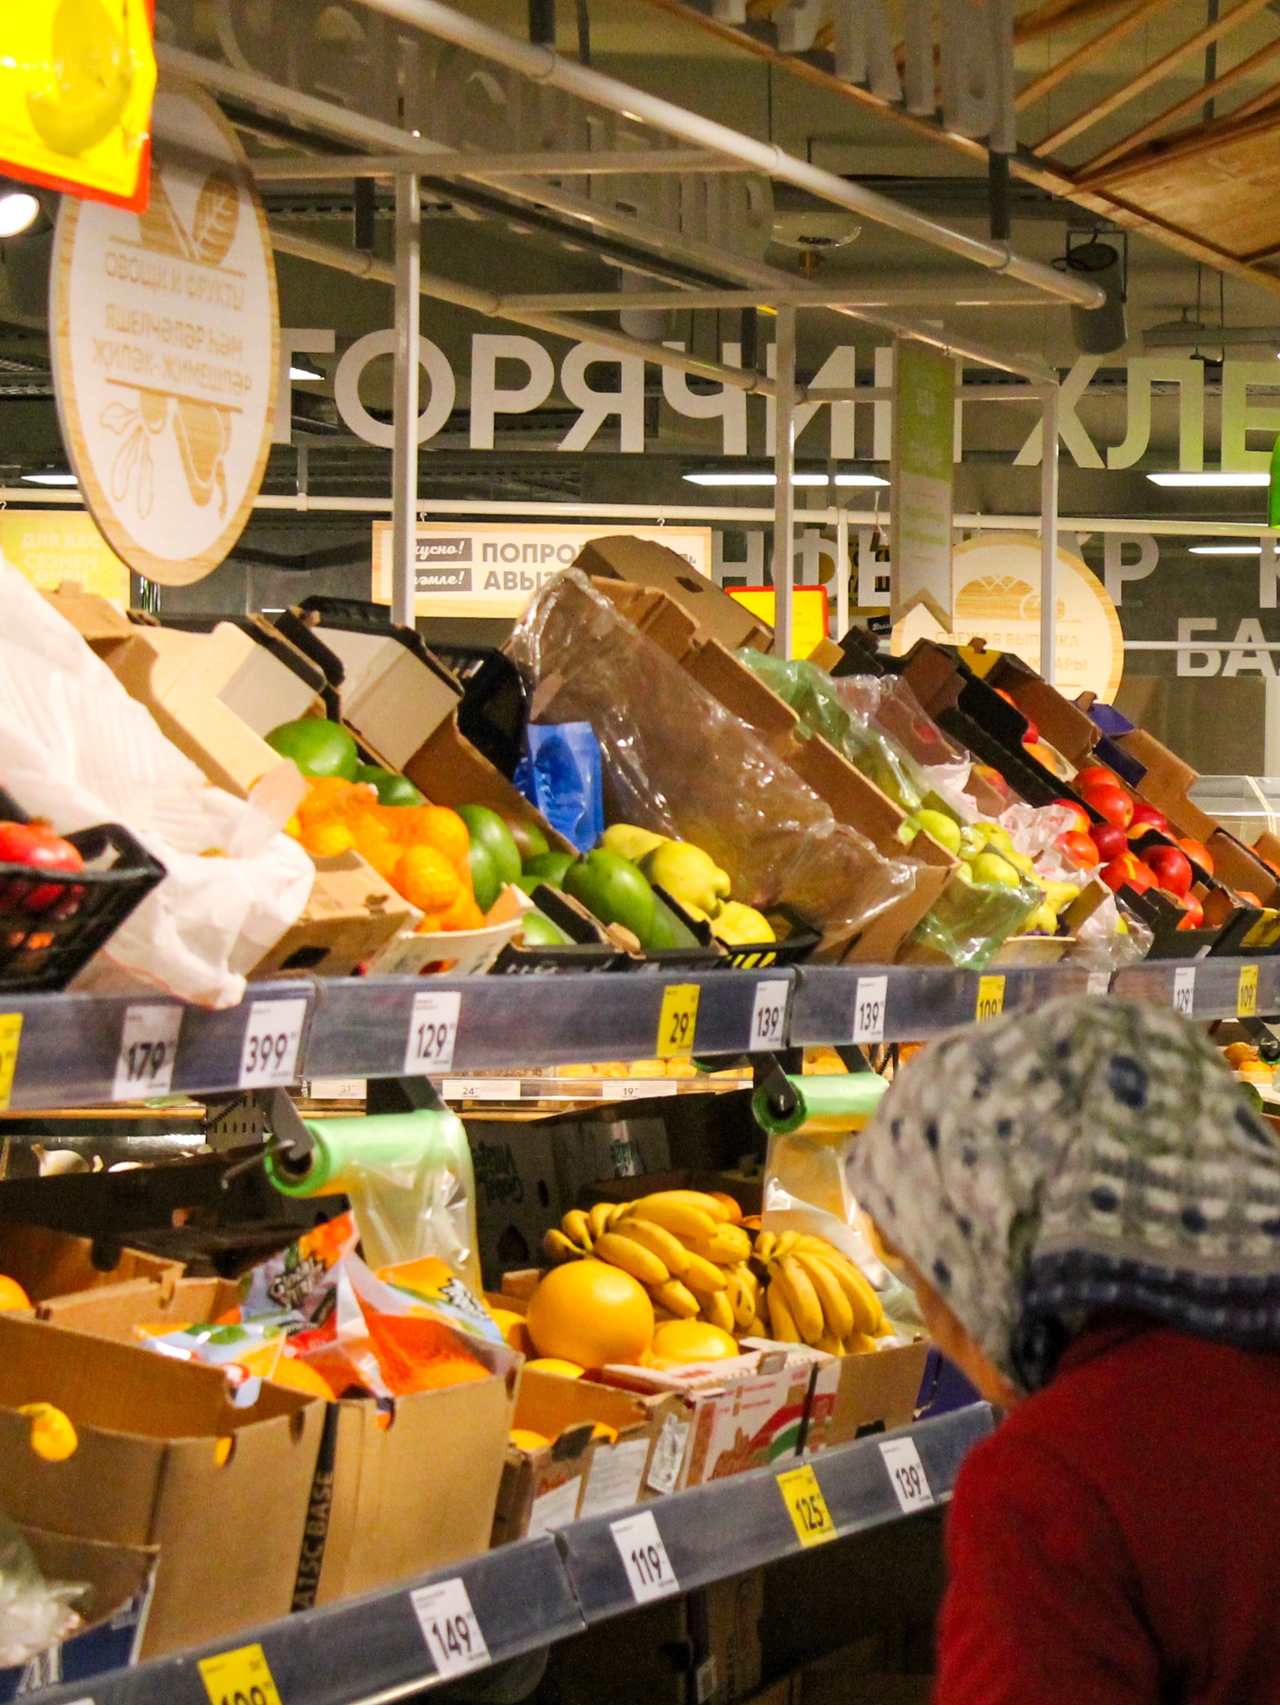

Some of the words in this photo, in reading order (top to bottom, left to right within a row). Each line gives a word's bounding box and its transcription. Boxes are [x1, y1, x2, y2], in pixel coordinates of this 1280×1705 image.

[273, 319, 963, 463] ГОРЯЧИ
[415, 541, 465, 560] кусно!
[670, 1012, 690, 1044] 29
[757, 1006, 780, 1037] 139
[860, 1001, 880, 1031] 139
[245, 1032, 288, 1073] 399
[416, 1022, 448, 1058] 129
[895, 1464, 923, 1498] 139
[796, 1496, 825, 1531] 125
[631, 1547, 662, 1585] 119
[432, 1614, 471, 1658] 149
